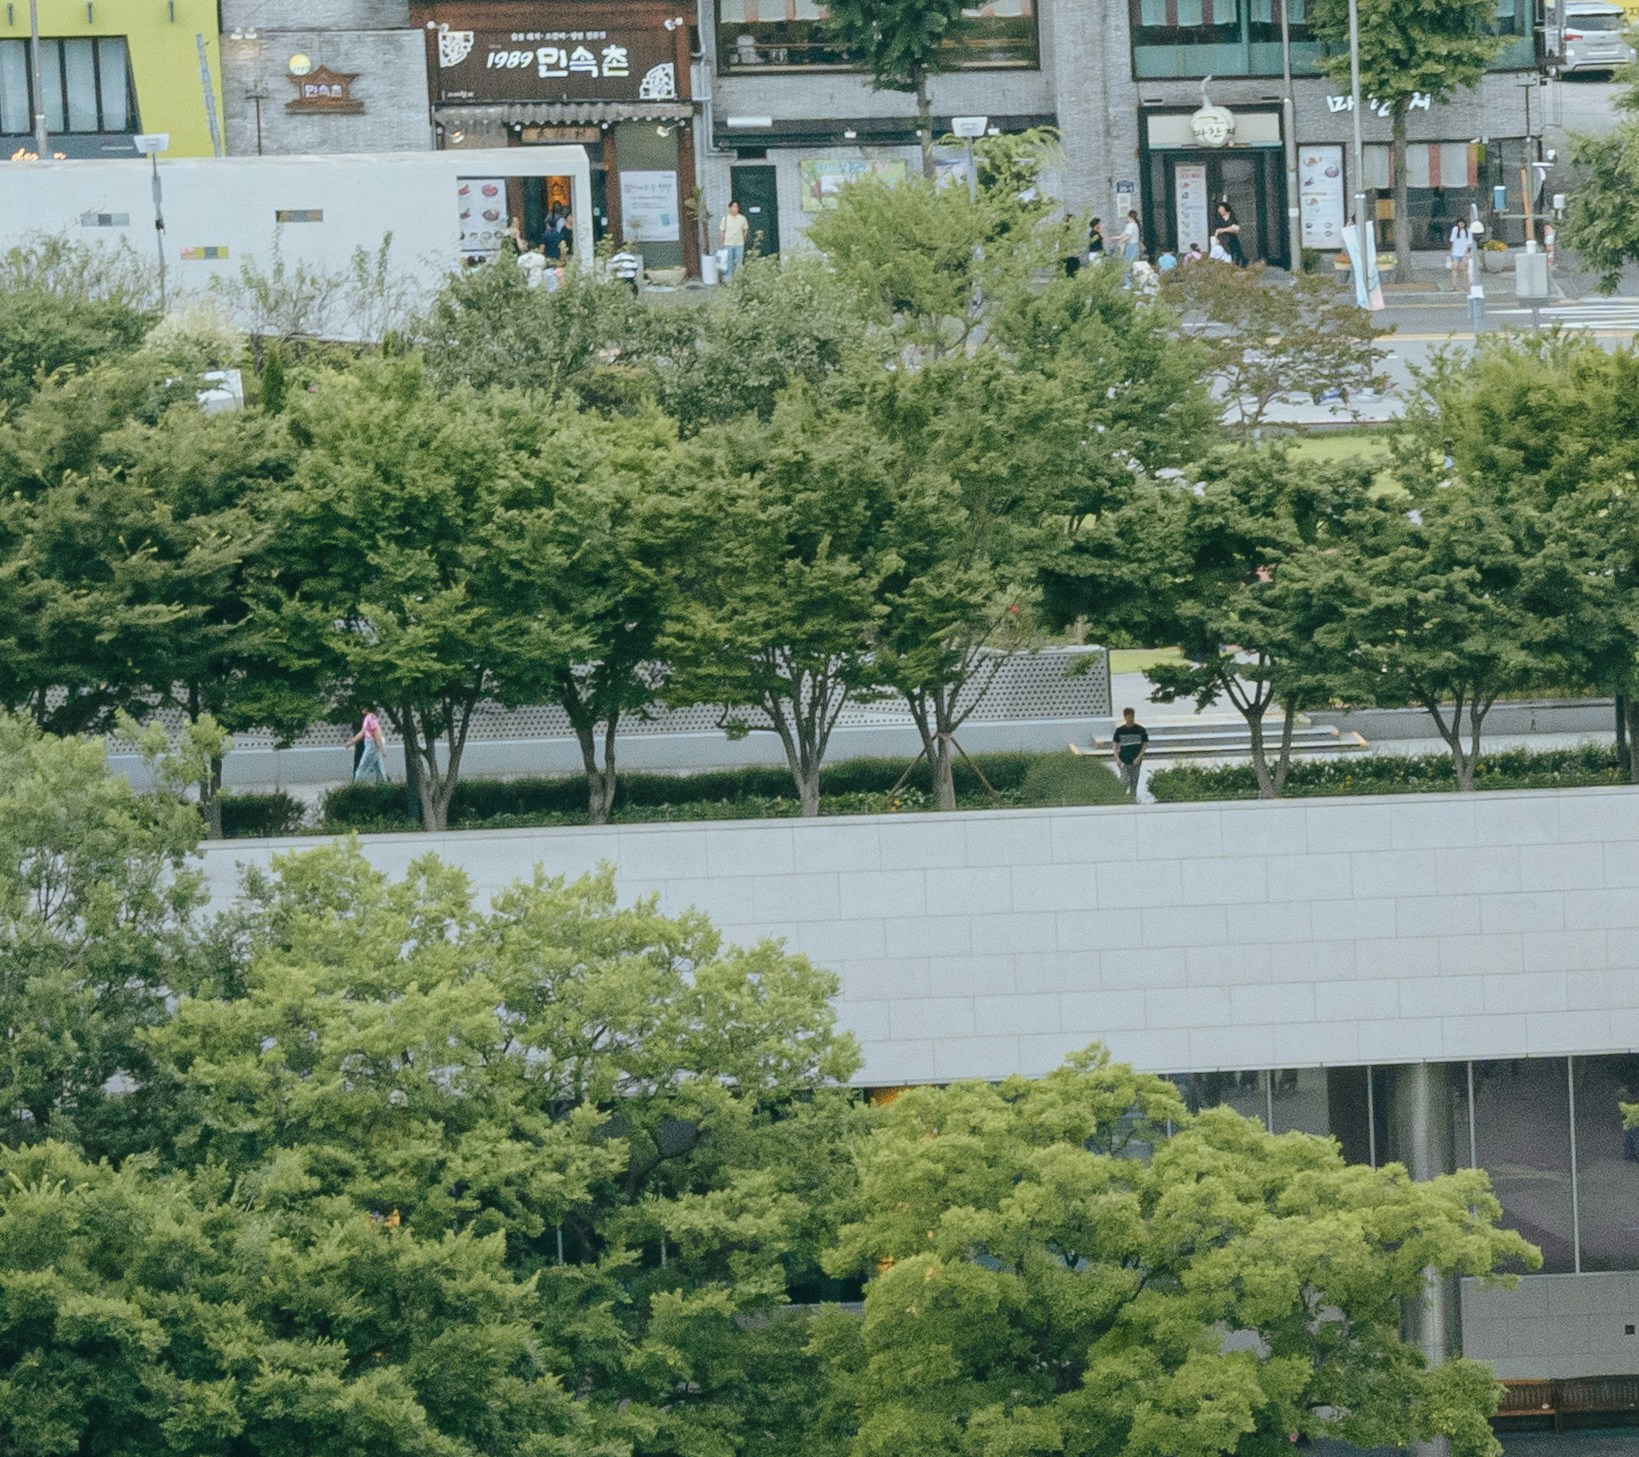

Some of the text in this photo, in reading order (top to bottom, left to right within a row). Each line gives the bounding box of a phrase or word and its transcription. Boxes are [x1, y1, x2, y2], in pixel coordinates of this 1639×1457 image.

[486, 45, 630, 78] 1989 민속촌
[304, 84, 343, 98] 민속촌
